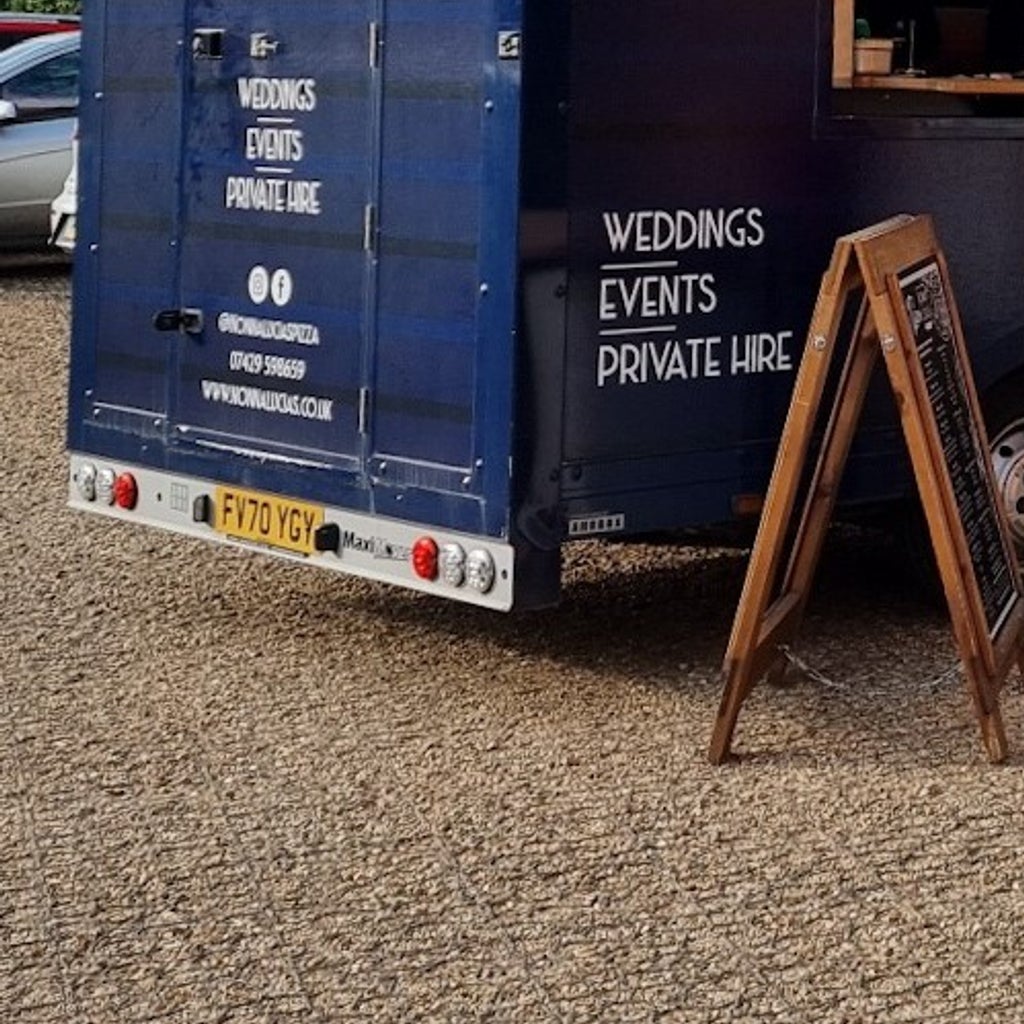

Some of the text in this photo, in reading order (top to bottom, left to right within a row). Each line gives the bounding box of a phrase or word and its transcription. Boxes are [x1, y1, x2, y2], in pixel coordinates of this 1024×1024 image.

[237, 78, 317, 112] WEDDINGS
[245, 127, 304, 162] EVENTS
[226, 176, 323, 216] PRIVATE HIRE
[602, 207, 765, 253] WEDDINGS
[599, 272, 718, 320] EVENTS
[229, 350, 262, 374] 07429
[597, 330, 793, 387] PRIVATE HIRE
[222, 492, 316, 546] FV70 YGY
